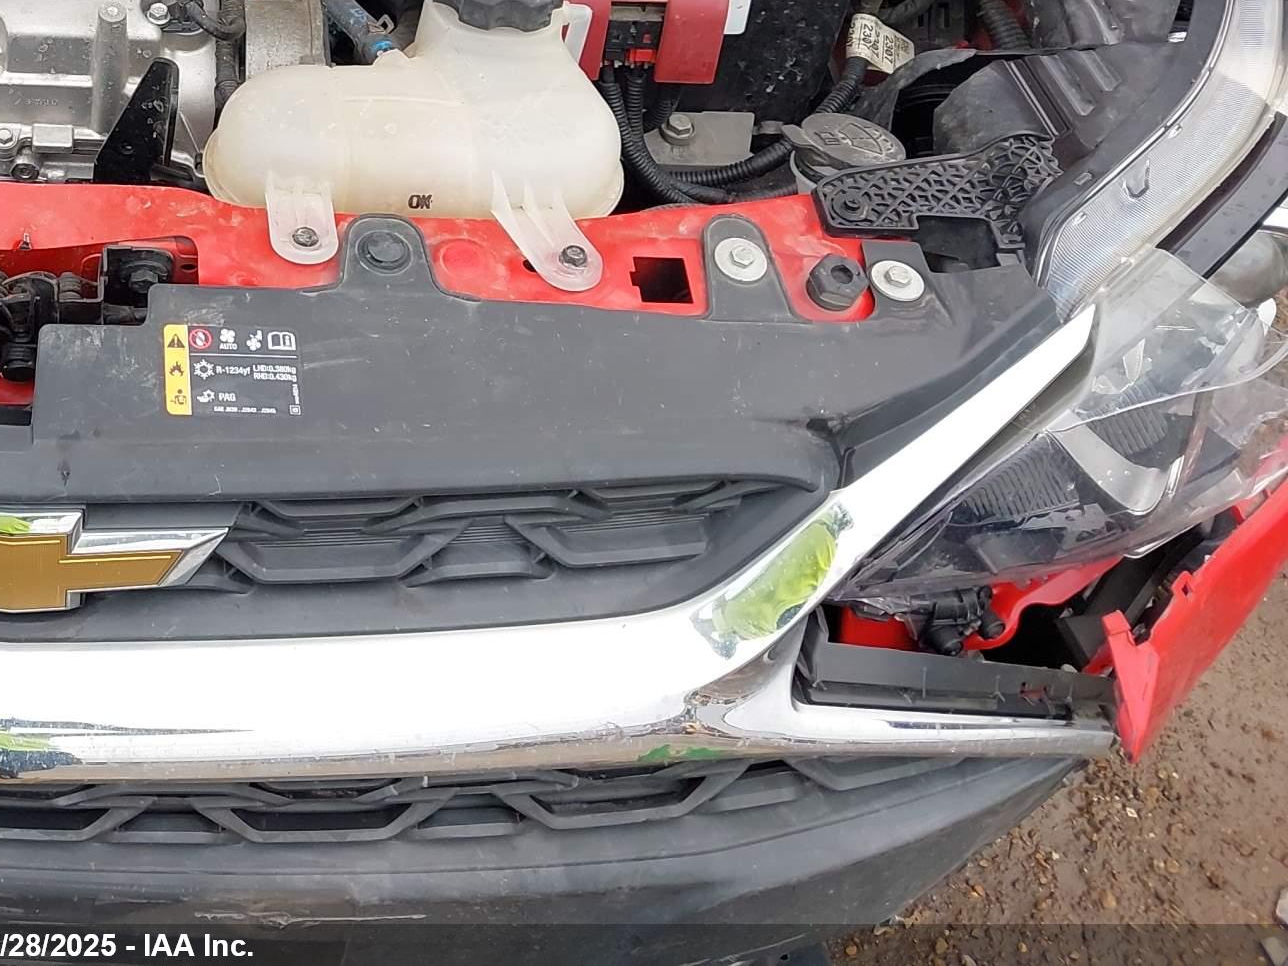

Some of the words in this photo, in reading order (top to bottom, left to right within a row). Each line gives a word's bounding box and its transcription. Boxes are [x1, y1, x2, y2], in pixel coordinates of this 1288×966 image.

[862, 23, 873, 50] 2307
[885, 35, 894, 64] 2307
[408, 194, 432, 209] OK
[219, 342, 238, 350] AUTO
[215, 365, 251, 377] R-1234yf
[218, 392, 237, 402] PAG
